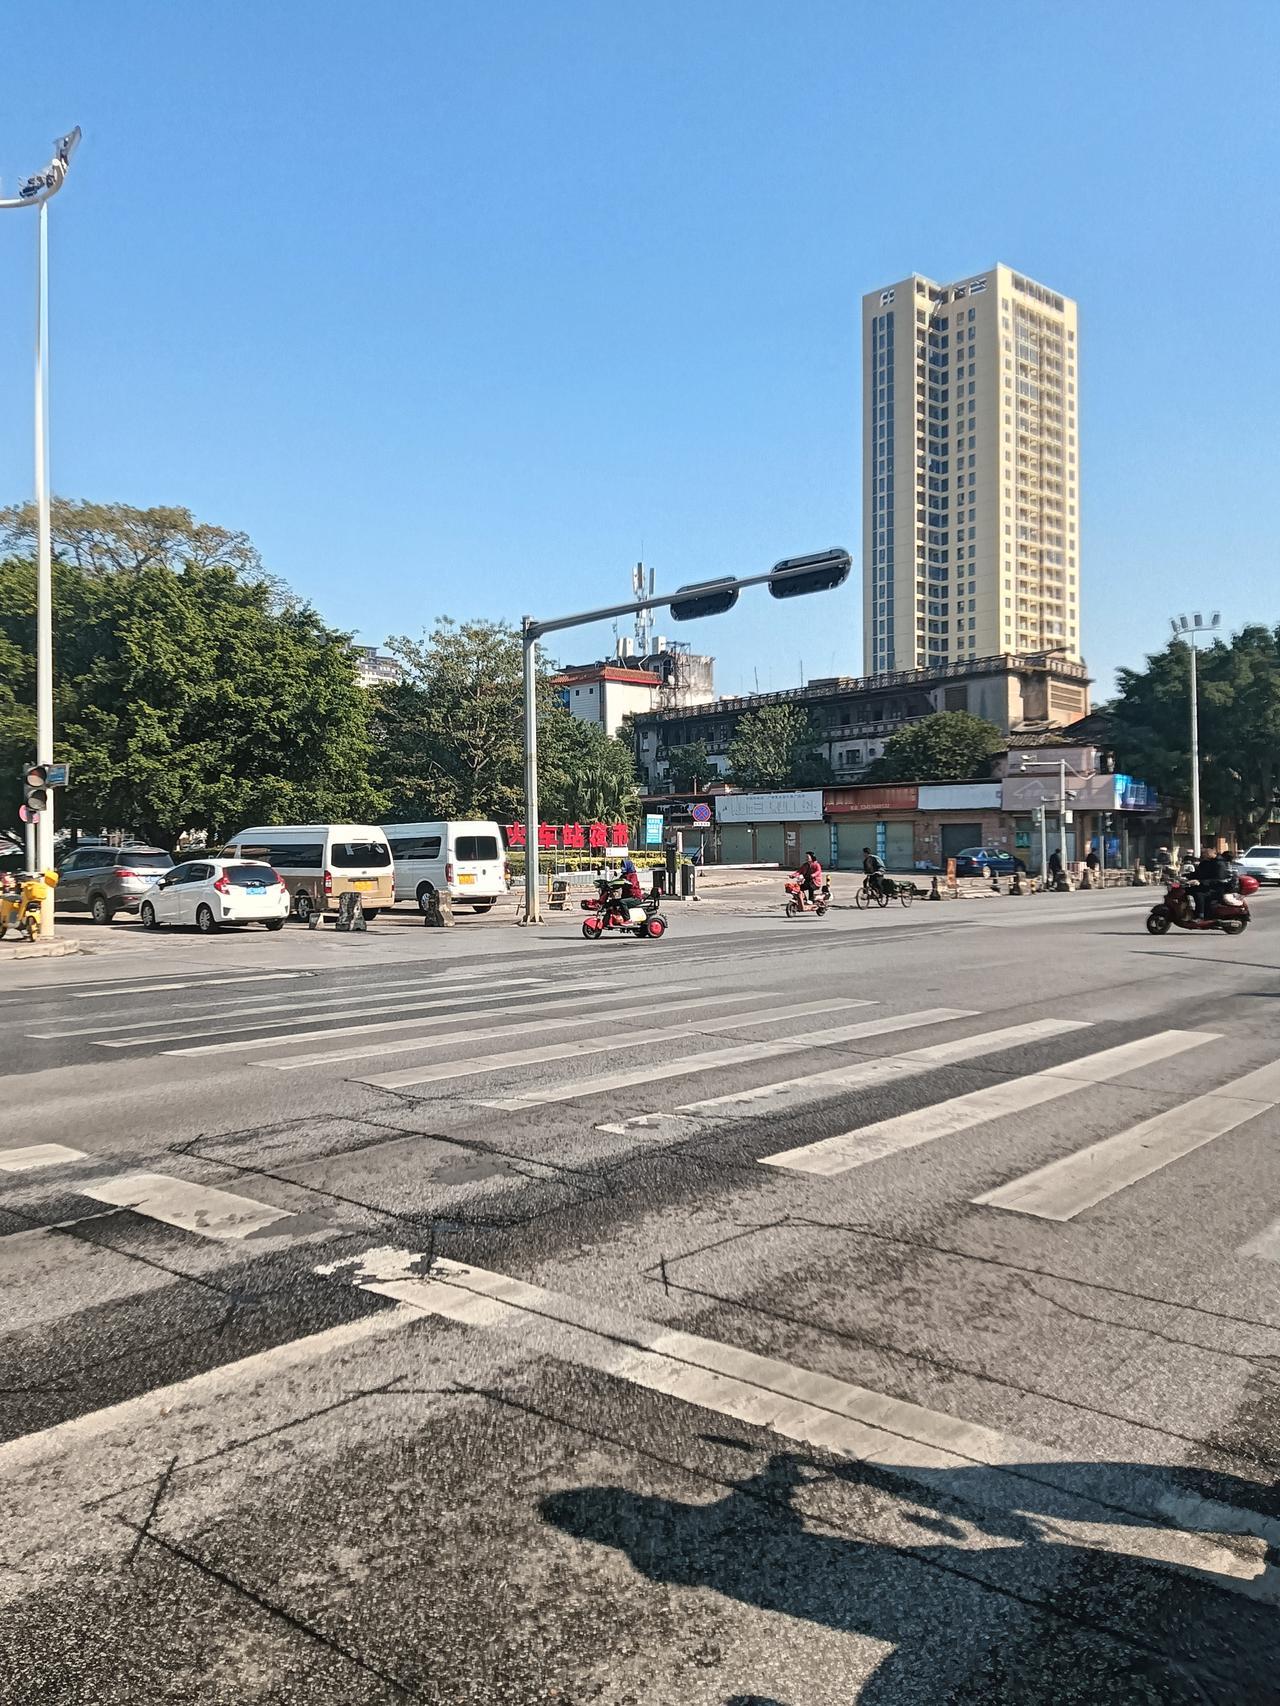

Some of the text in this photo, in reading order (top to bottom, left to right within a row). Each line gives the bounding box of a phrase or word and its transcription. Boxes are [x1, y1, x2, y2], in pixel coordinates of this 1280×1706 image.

[506, 821, 629, 848] 火车站夜市
